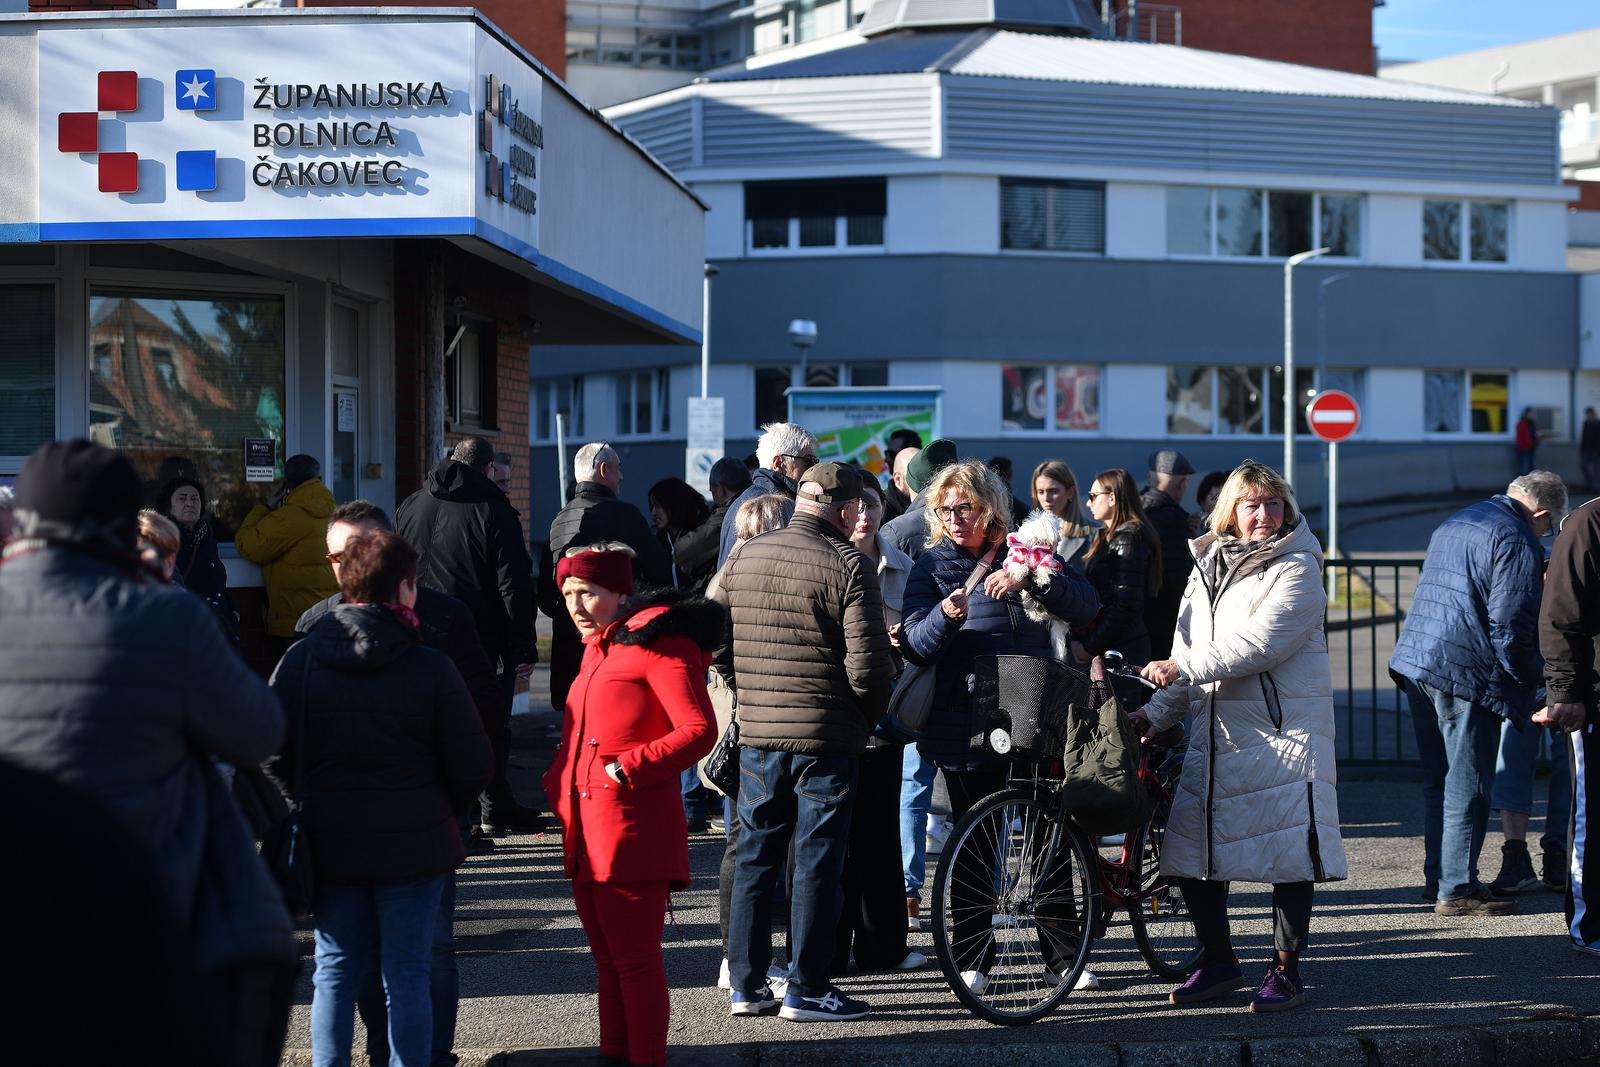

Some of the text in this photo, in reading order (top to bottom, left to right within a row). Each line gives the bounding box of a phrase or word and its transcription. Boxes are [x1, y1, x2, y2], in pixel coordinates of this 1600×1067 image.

[253, 76, 448, 109] ŽUPANIJSKA
[253, 121, 396, 148] BOLNICA
[252, 154, 403, 187] ČAKOVEC
